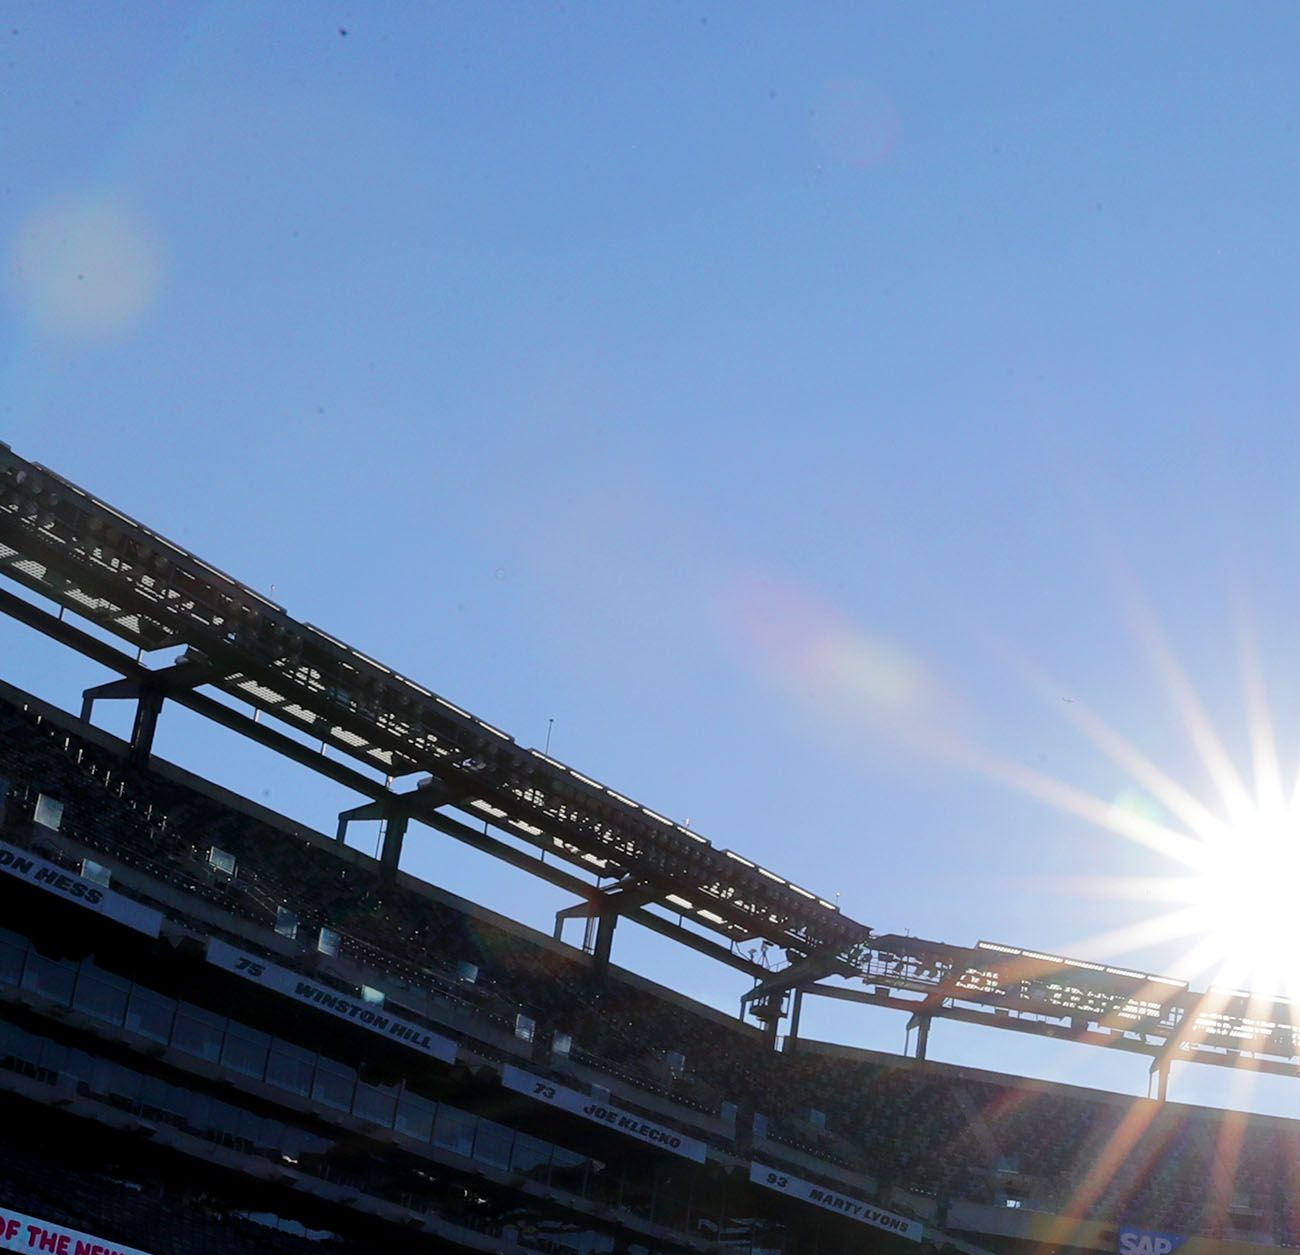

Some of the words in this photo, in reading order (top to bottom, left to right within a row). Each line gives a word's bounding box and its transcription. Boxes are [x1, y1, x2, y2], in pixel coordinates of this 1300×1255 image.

[34, 868, 103, 904] HESS
[236, 957, 265, 977] 75
[295, 982, 389, 1030] WINSTON
[389, 1024, 432, 1049] HILL
[533, 1082, 556, 1099] 73
[583, 1104, 619, 1123] JOE
[618, 1116, 681, 1148] KLECKO
[766, 1173, 788, 1188] 93
[809, 1189, 862, 1214] MARTY
[864, 1210, 909, 1233] LYONS
